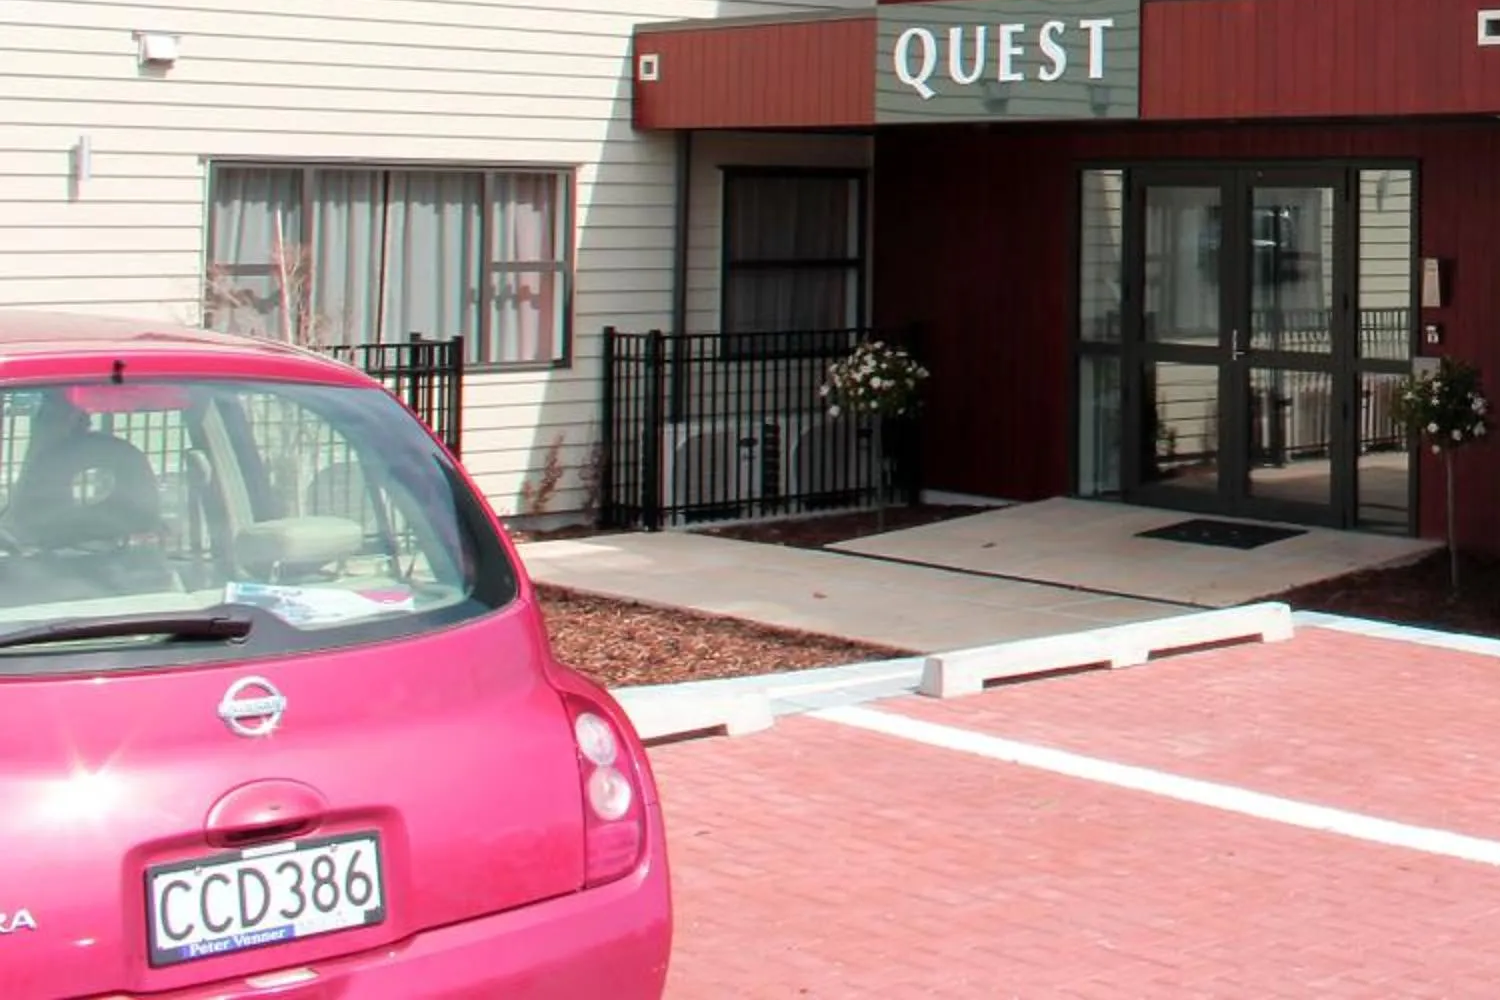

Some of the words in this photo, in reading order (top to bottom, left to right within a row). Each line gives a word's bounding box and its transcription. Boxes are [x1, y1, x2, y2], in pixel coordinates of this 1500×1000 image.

[894, 18, 1114, 100] QUEST
[160, 849, 373, 941] CCD386
[189, 937, 230, 958] Peter
